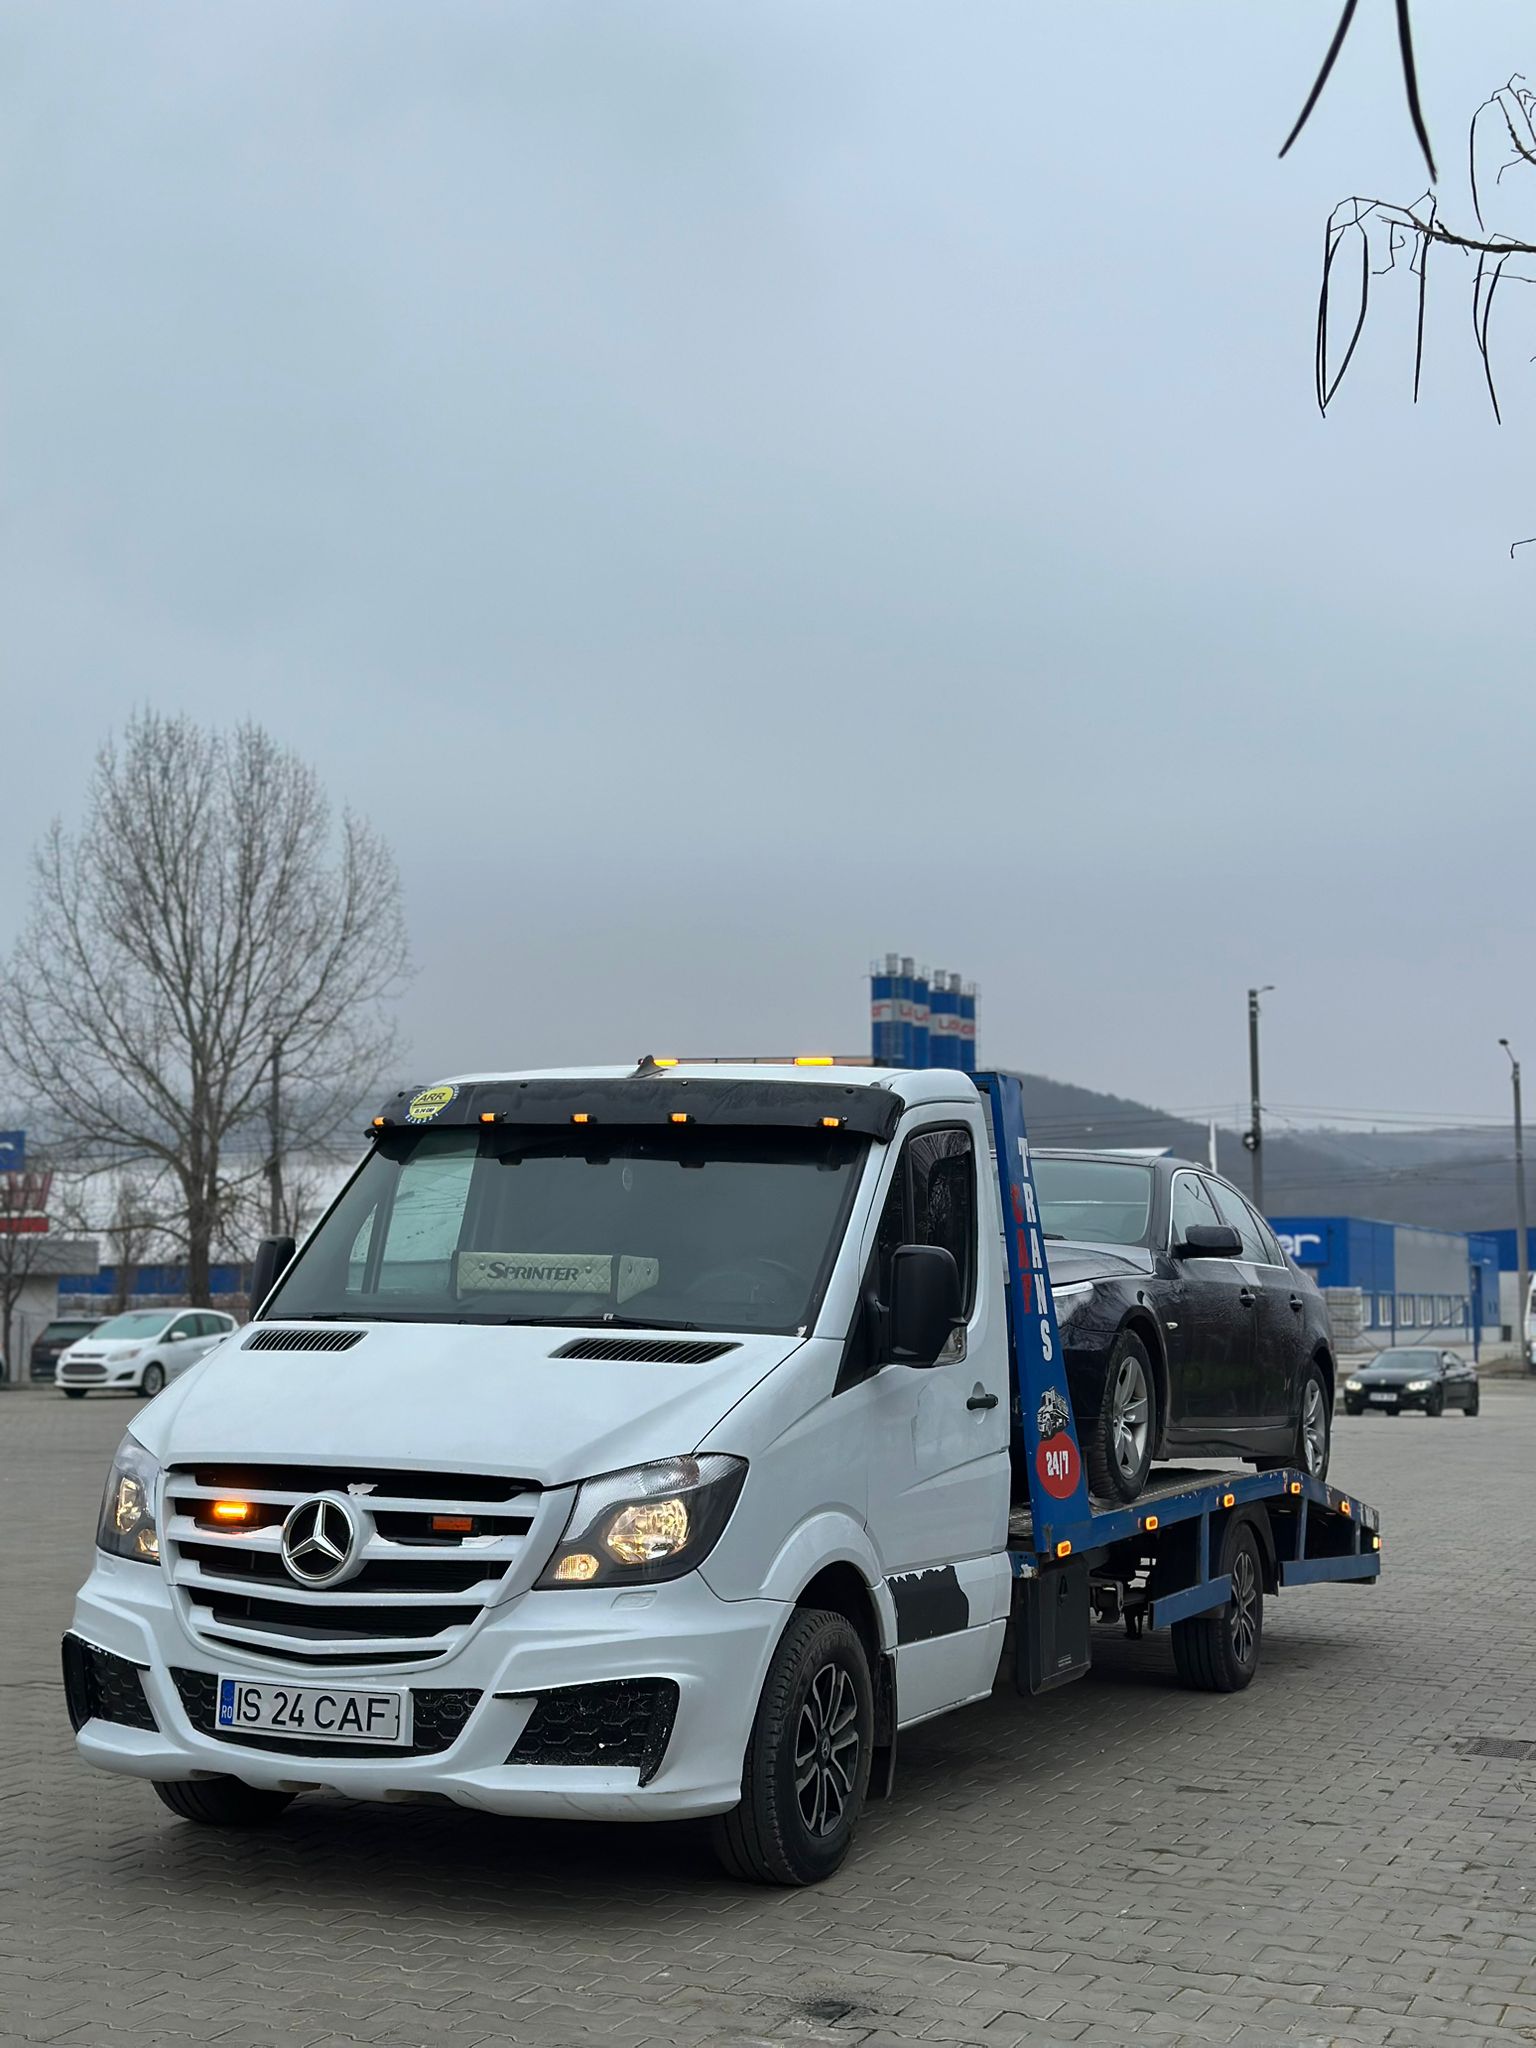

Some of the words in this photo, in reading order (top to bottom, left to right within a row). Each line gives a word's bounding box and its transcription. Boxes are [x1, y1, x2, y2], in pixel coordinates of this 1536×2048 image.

[419, 1092, 446, 1102] ARR
[1017, 1136, 1053, 1362] TRANS
[221, 1705, 233, 1719] RO
[236, 1687, 262, 1722] IS
[271, 1691, 304, 1727] 24
[314, 1695, 391, 1732] CAF
